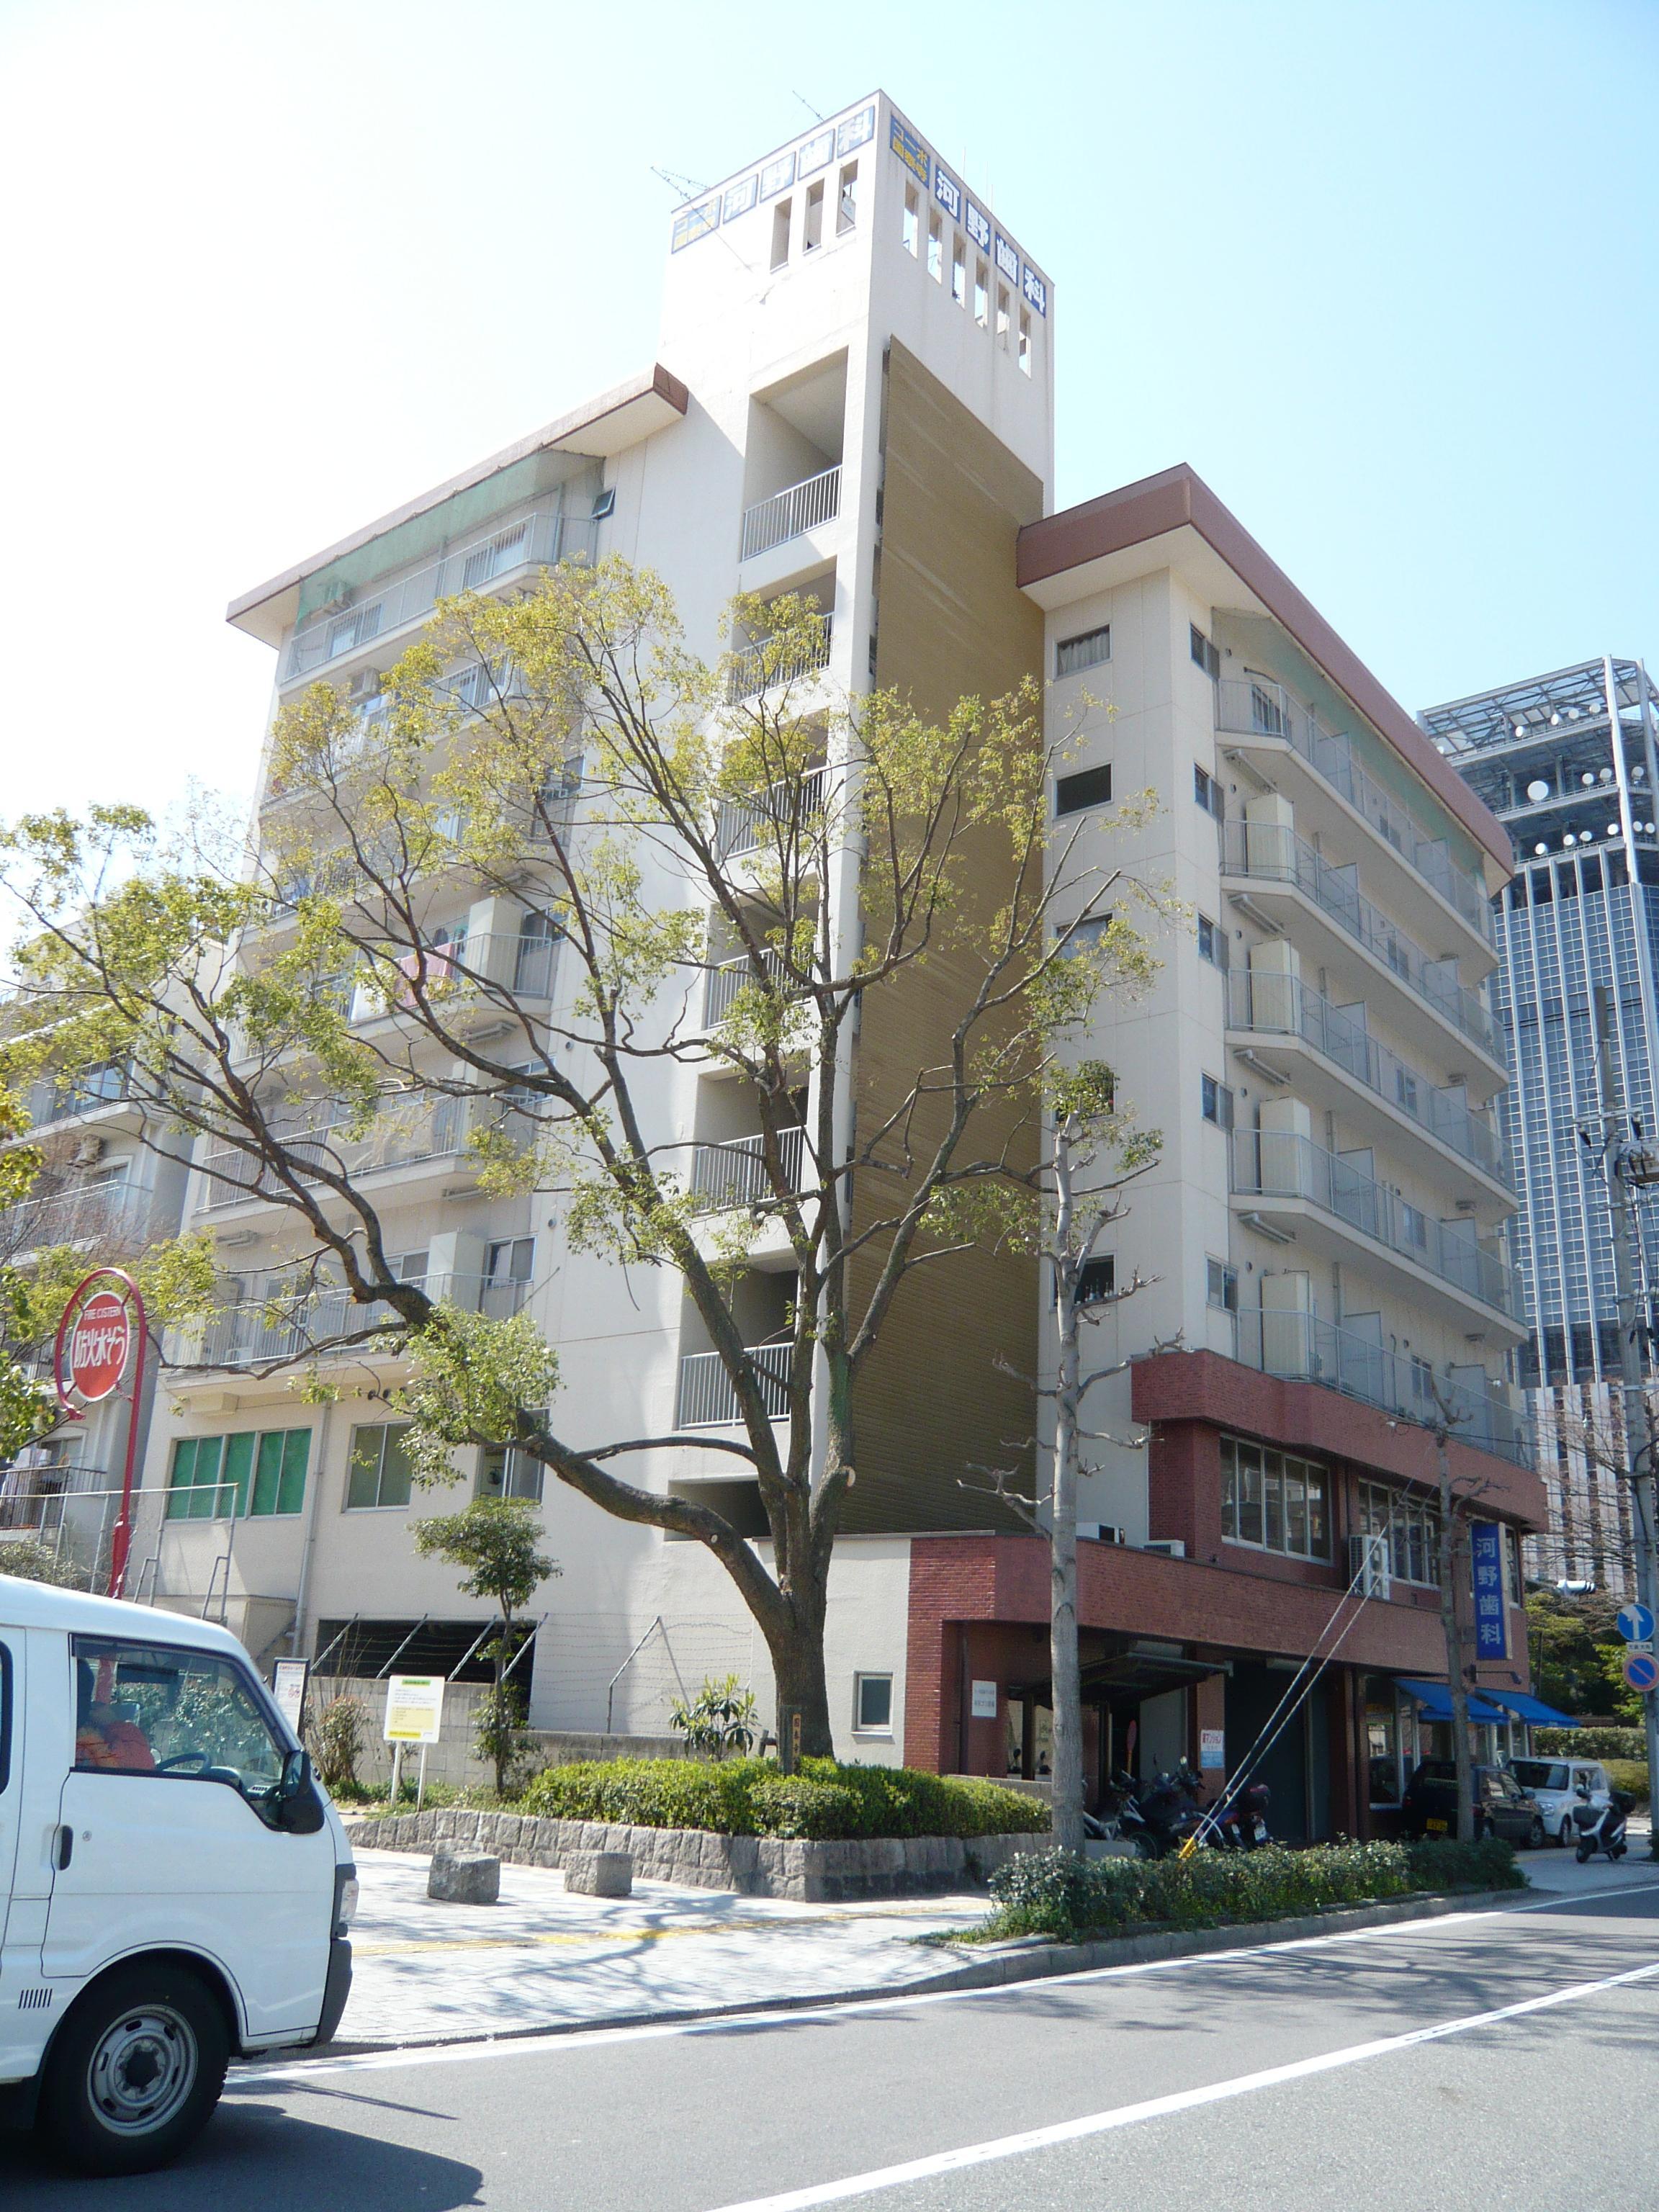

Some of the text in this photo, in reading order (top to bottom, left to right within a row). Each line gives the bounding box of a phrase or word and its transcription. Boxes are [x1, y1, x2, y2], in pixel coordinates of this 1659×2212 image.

[937, 170, 1045, 313] 河野歯科
[73, 1326, 125, 1368] 防火水そう
[84, 1309, 96, 1321] FIRE
[1476, 1537, 1501, 1645] 河野歯科
